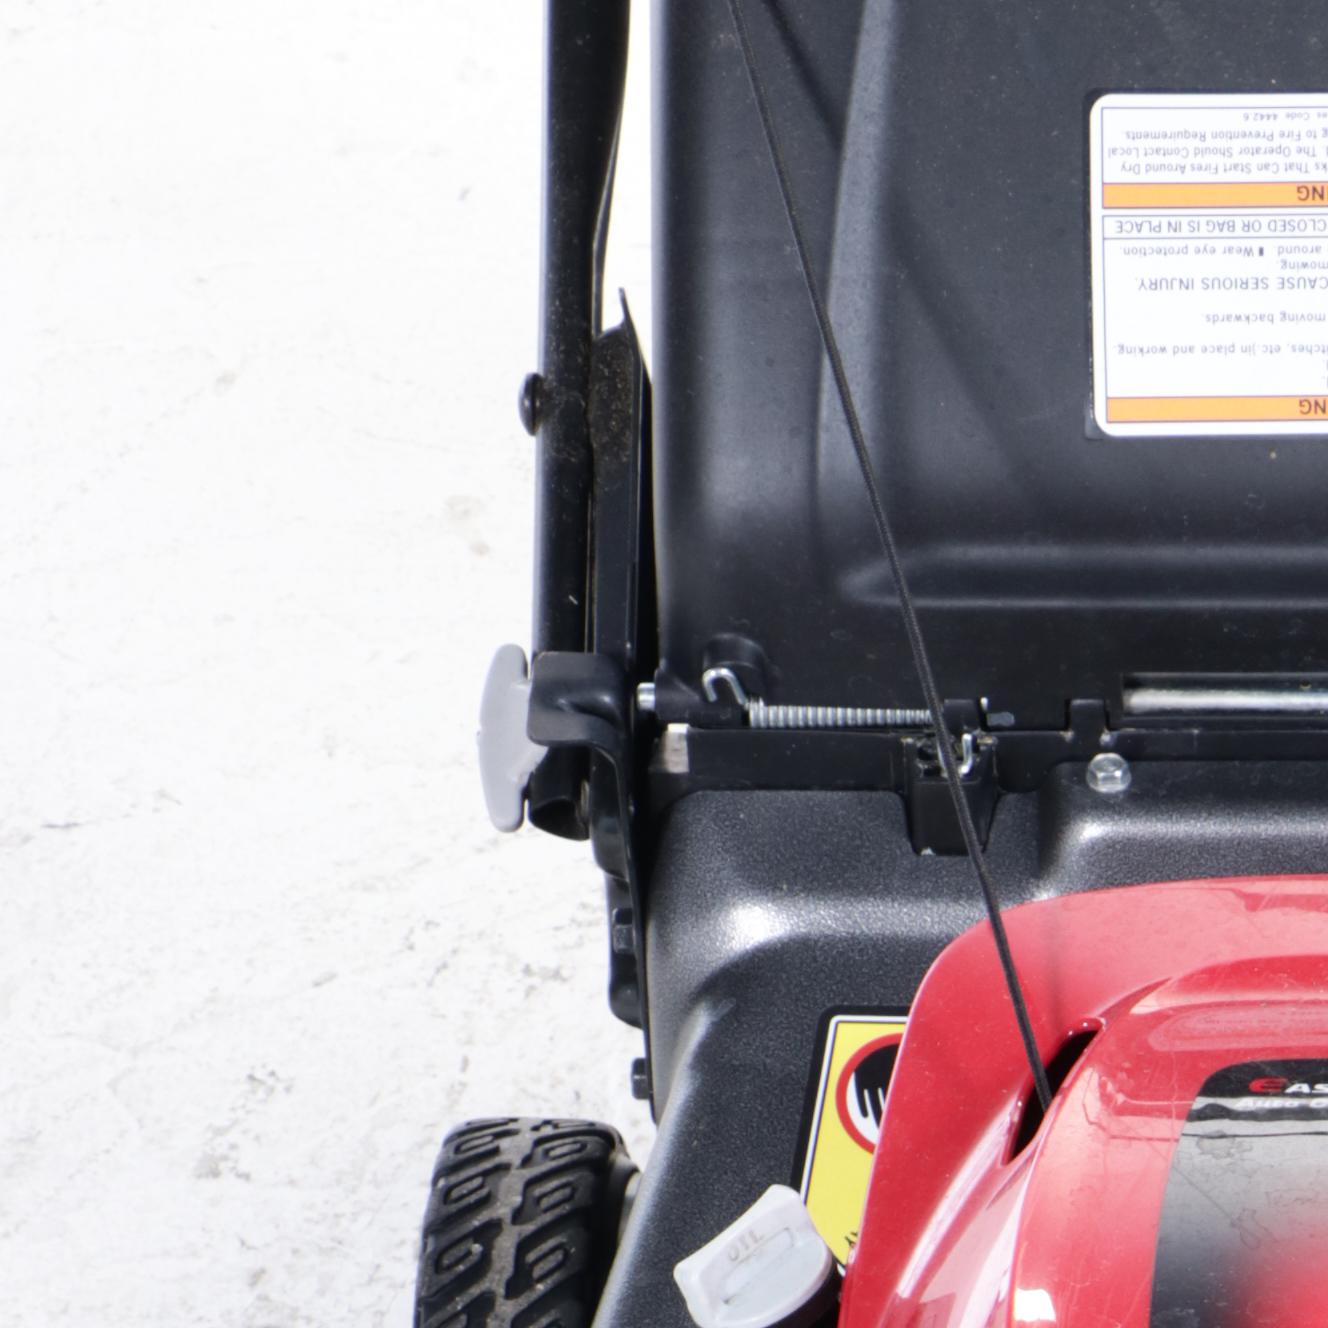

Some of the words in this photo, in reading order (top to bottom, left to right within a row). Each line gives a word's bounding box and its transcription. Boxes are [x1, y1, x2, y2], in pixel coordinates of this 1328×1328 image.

[1242, 112, 1279, 122] 4442.6
[1285, 112, 1311, 121] Code
[1121, 128, 1207, 143] Requirements.
[1210, 130, 1274, 142] Prevention
[1278, 130, 1302, 142] Fire
[1305, 129, 1318, 140] to
[1107, 147, 1140, 159] Local
[1143, 146, 1190, 159] Contact
[1193, 146, 1234, 159] Should
[1238, 144, 1292, 158] Operator
[1295, 146, 1318, 158] The
[1120, 161, 1141, 176] Dry
[1144, 163, 1187, 175] Around
[1189, 163, 1219, 175] Fires
[1223, 162, 1252, 175] Start
[1256, 162, 1280, 175] Can
[1283, 161, 1311, 174] That
[1115, 220, 1162, 234] PLACE
[1167, 220, 1182, 233] IN
[1187, 219, 1201, 233] IS
[1205, 219, 1236, 233] BAG
[1241, 219, 1262, 233] OR
[1267, 218, 1328, 233] CLOSED
[1120, 244, 1189, 257] protection.
[1193, 243, 1217, 256] eye
[1222, 246, 1255, 258] Wear
[1135, 277, 1195, 291] INJURY.
[1201, 277, 1270, 291] SERIOUS
[1202, 313, 1275, 325] backwards.
[1279, 311, 1326, 323] moving
[1113, 343, 1168, 357] working.
[1172, 345, 1196, 357] and
[1200, 342, 1236, 356] place
